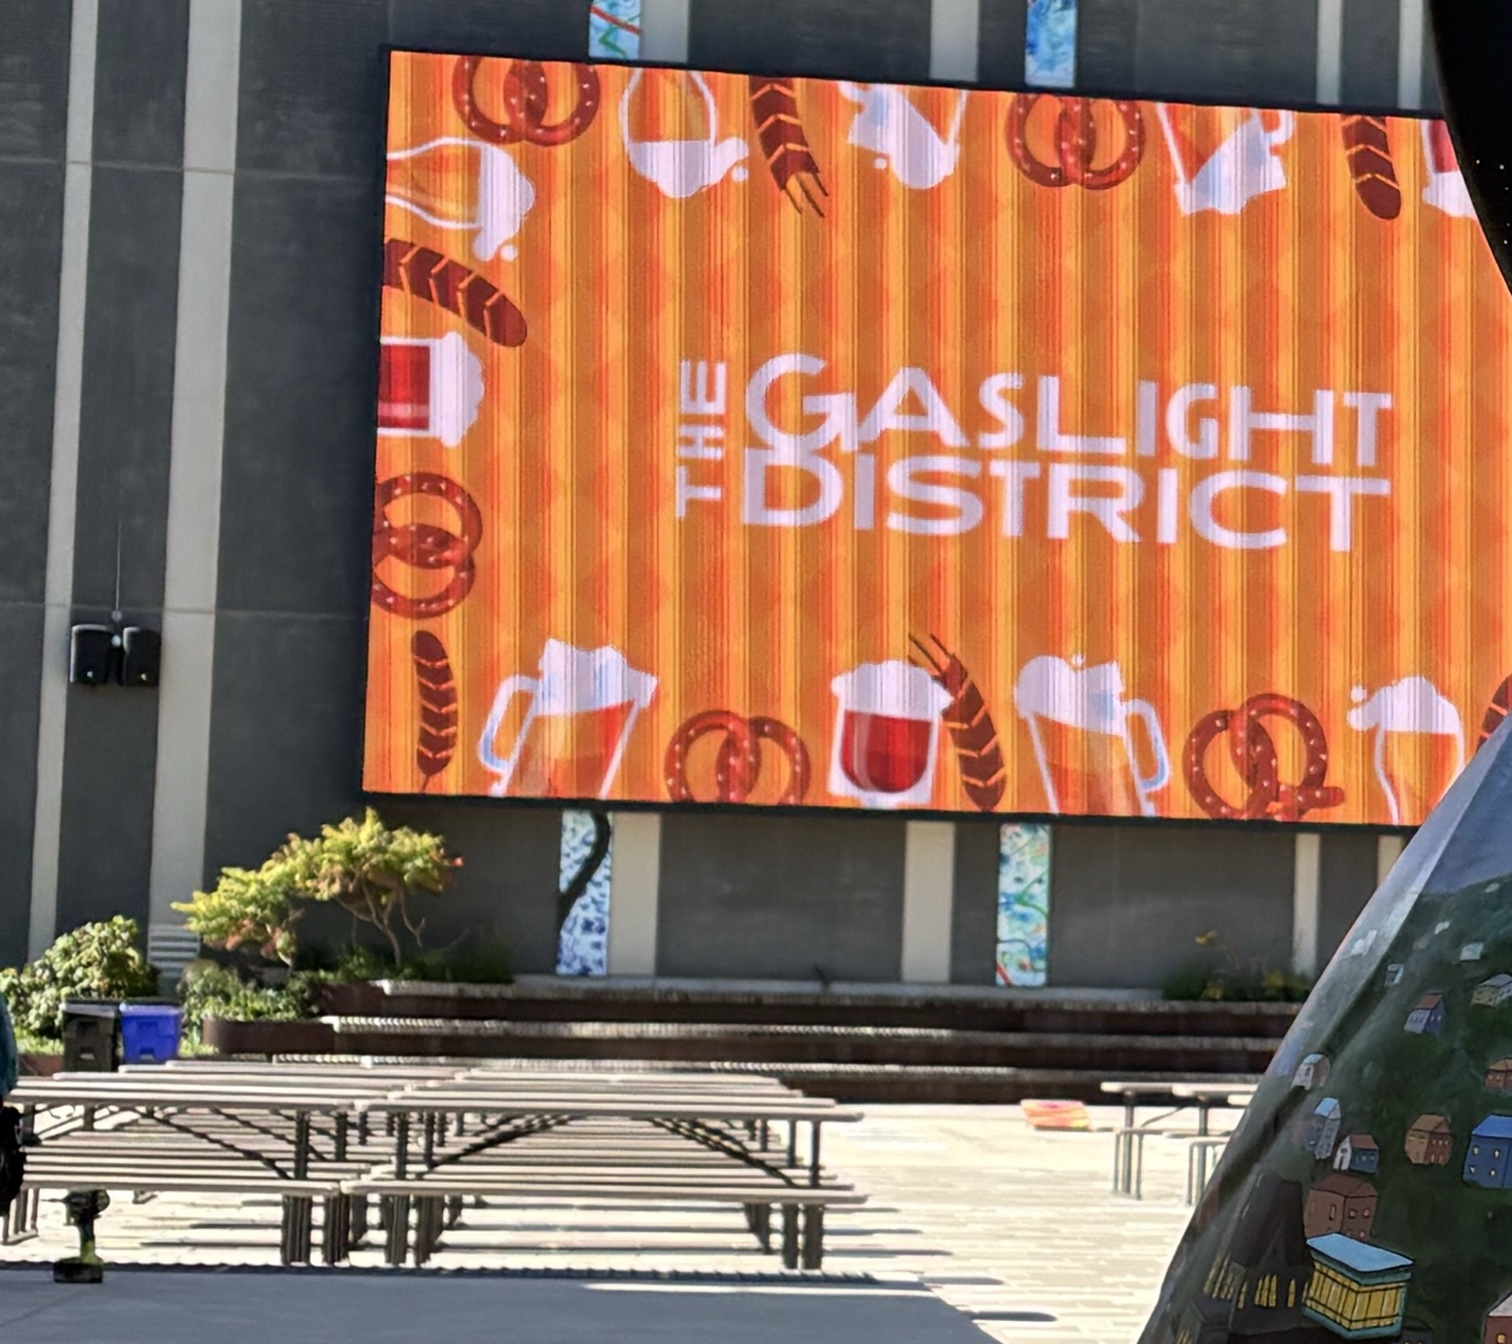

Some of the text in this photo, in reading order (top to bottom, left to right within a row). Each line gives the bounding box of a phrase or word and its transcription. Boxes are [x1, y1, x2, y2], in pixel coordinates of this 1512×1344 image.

[676, 361, 726, 517] THE
[742, 353, 1392, 466] GASLIGHT
[741, 449, 1391, 552] DISTRICT
